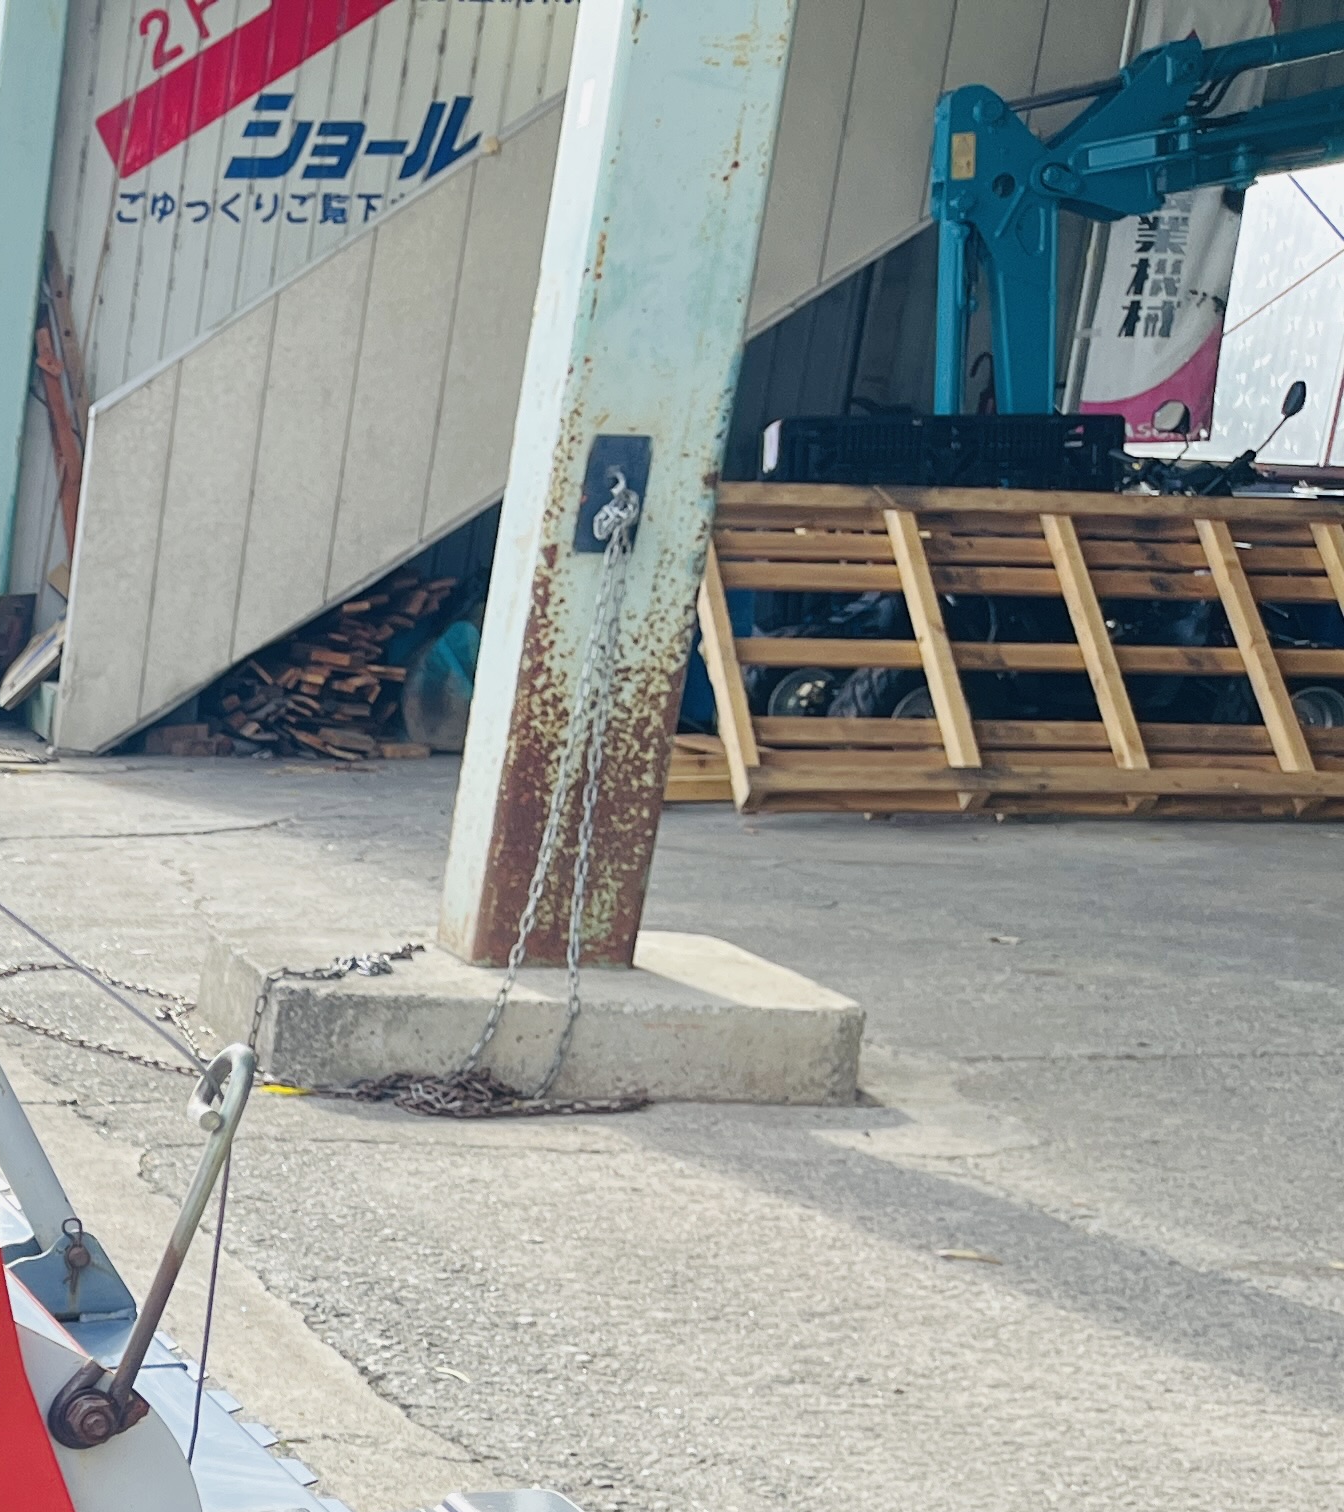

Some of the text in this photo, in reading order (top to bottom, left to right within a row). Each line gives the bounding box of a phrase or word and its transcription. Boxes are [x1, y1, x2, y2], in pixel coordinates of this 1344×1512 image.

[224, 93, 482, 181] ショール
[116, 191, 405, 224] ごゆっくりご覧下
